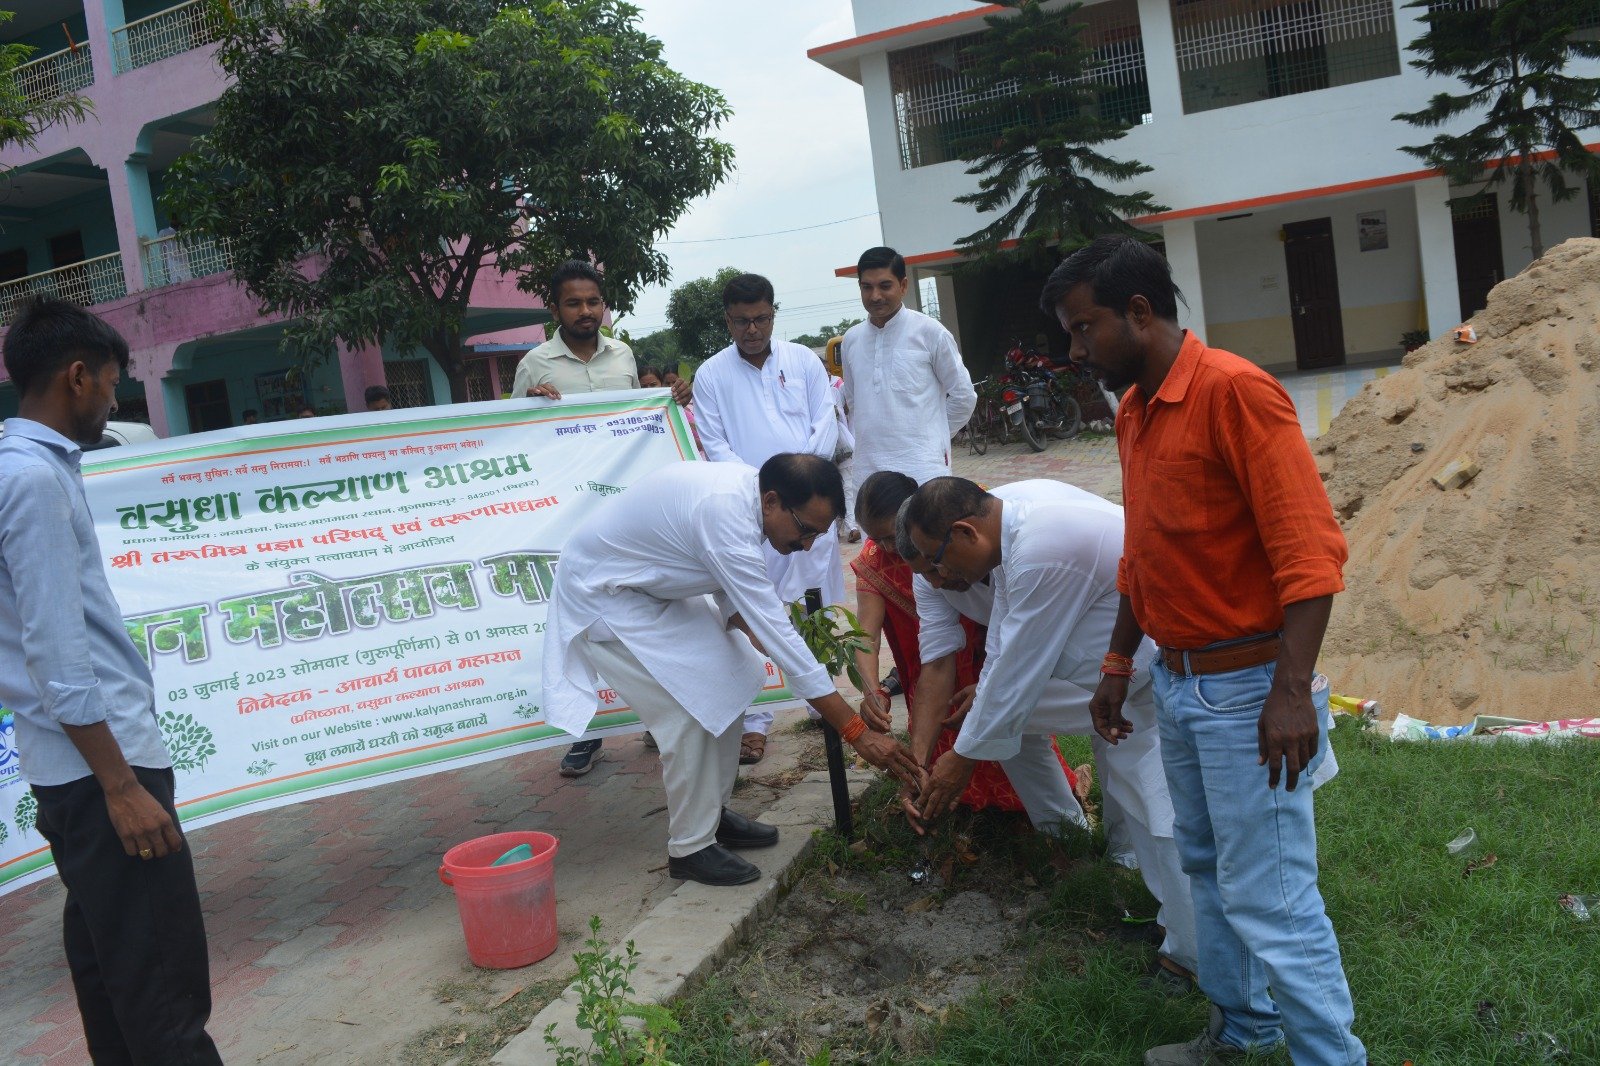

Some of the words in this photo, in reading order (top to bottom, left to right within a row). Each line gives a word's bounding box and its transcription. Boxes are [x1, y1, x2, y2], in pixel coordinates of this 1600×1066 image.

[116, 491, 244, 534] वसुधा
[254, 470, 410, 514] कल्याण
[423, 453, 533, 489] आश्रम
[161, 473, 175, 485] सर्वे
[318, 453, 332, 465] सर्वे
[335, 451, 359, 463] भद्राणि
[388, 449, 398, 457] मा
[467, 489, 500, 500] 842001
[503, 479, 539, 492] (बिहार)
[109, 550, 142, 569] श्री
[152, 544, 248, 564] तरूमित्र
[256, 537, 304, 553] प्रज्ञा
[311, 526, 389, 546] परिषद्
[391, 516, 423, 535] एवं
[427, 495, 560, 527] वरूणाराधना
[245, 558, 260, 571] के
[265, 557, 310, 570] संयुक्त
[382, 544, 394, 555] में
[399, 534, 455, 552] आयोजित
[218, 561, 479, 648] महोत्सव
[168, 688, 188, 702] 03
[193, 671, 240, 700] जुलाई
[246, 668, 286, 686] 2023
[291, 654, 350, 676] सोमवार
[445, 630, 460, 645] से
[465, 629, 480, 642] 01
[486, 624, 529, 639] अगस्त
[237, 688, 312, 715] निवेदक
[335, 667, 399, 694] आचार्य
[403, 660, 452, 679] पावन
[456, 649, 522, 670] महाराज
[356, 695, 392, 711] वसुधा
[396, 685, 441, 703] कल्याण
[444, 677, 486, 693] आश्रम)
[251, 737, 280, 752] Visit
[282, 735, 298, 746] on
[301, 730, 321, 742] our
[324, 719, 373, 737] Website
[381, 688, 528, 724] www.kalyanashram.org.in
[304, 748, 327, 766] वृक्ष
[330, 739, 366, 758] लगायें
[368, 731, 399, 750] धरती
[402, 727, 419, 741] को
[421, 723, 455, 739] समृद्ध
[457, 713, 488, 730] बनायें
